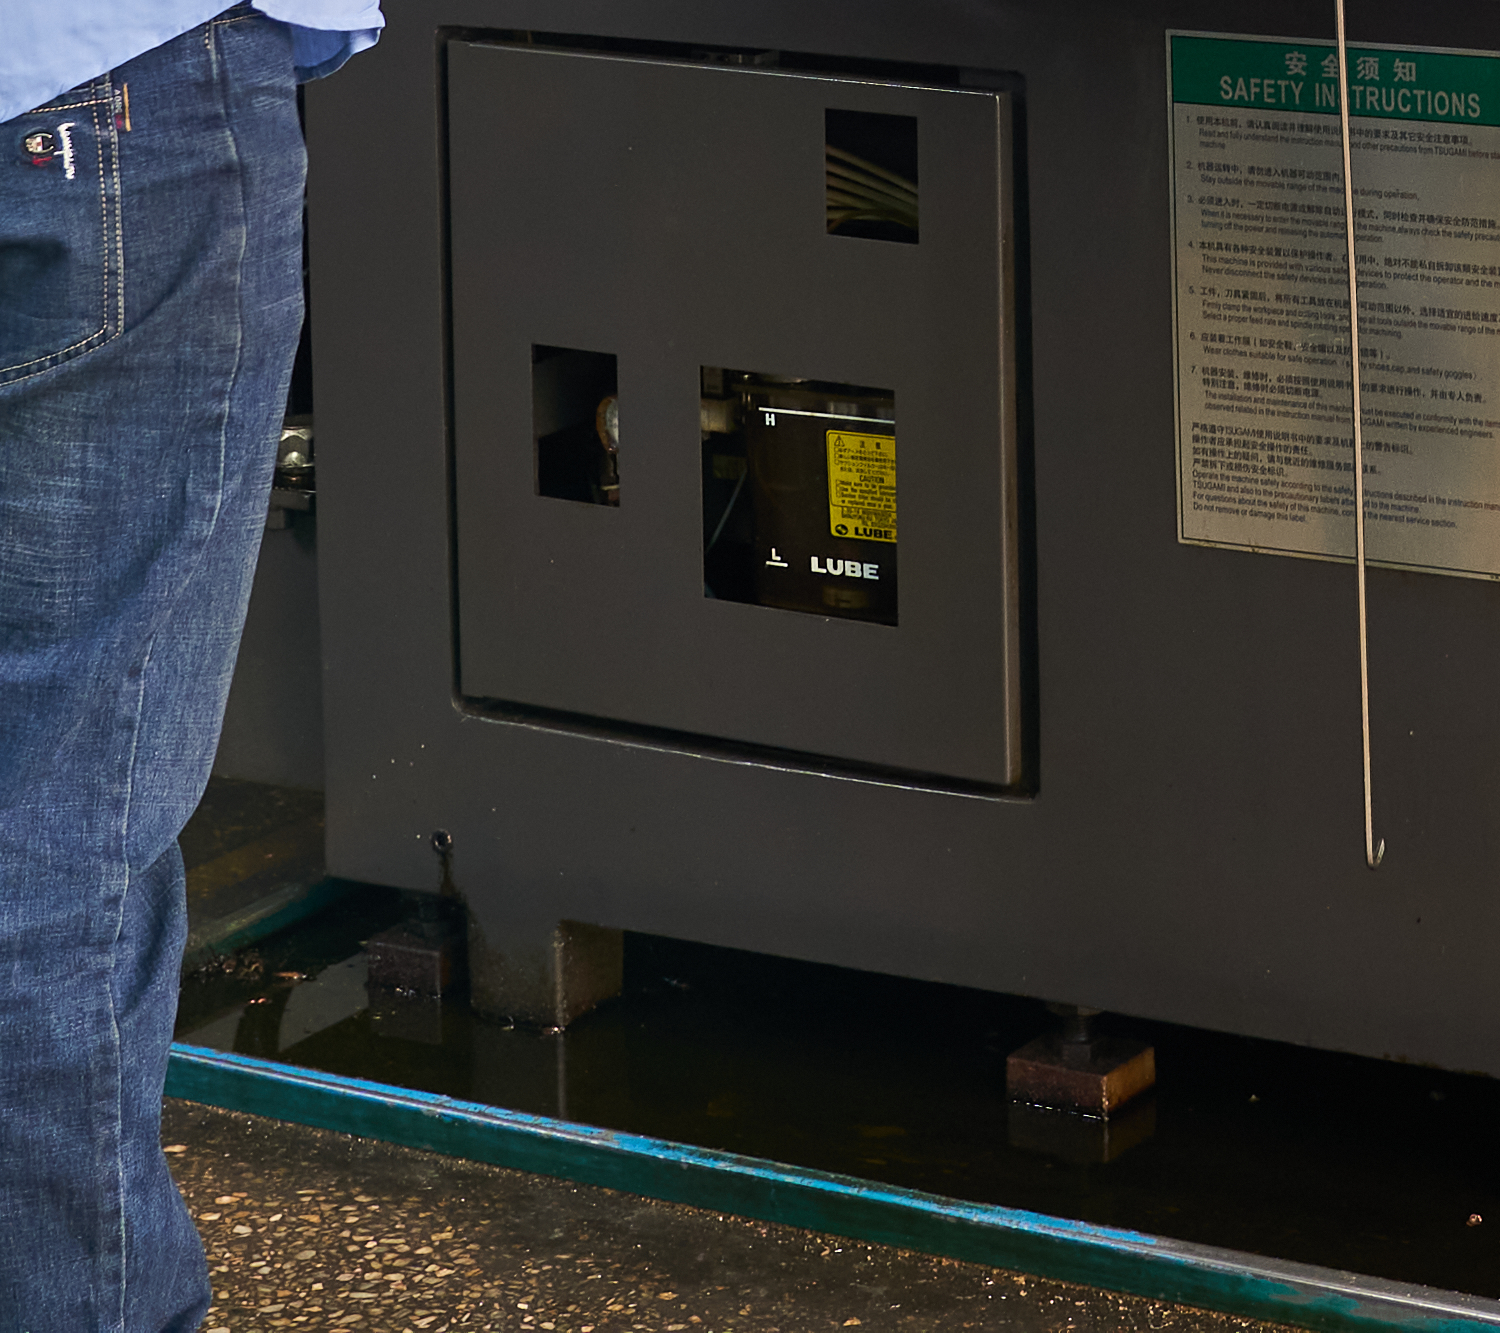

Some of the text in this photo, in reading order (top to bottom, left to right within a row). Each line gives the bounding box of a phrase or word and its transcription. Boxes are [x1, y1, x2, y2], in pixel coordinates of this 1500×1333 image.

[1285, 51, 1416, 82] 安全须知
[1220, 76, 1481, 118] SAFETY INTRUCTIONS
[1418, 145, 1466, 157] from TSUGAMI
[1201, 174, 1382, 197] Stay during
[1202, 254, 1492, 288] This provided to protect the operator and the
[1202, 265, 1298, 281] Never disconnect safety
[1204, 346, 1220, 356] Wear
[1222, 347, 1247, 358] clothes
[1276, 353, 1285, 362] for
[1287, 354, 1302, 364] safe
[1421, 367, 1442, 378] safety
[765, 413, 776, 427] H
[1192, 469, 1218, 480] Operate
[1219, 472, 1229, 482] the
[1231, 474, 1258, 485] machine
[1260, 477, 1279, 487] safely
[1281, 479, 1312, 491] according
[1314, 483, 1320, 492] to
[1394, 492, 1427, 504] described
[1436, 496, 1446, 506] the
[1448, 498, 1482, 510] instruction
[1193, 480, 1318, 503] TSUGAMI and also to the precautionary
[1193, 491, 1429, 526] For questions about the safety of this nearest service
[1193, 502, 1202, 511] Do
[1203, 503, 1214, 512] not
[1215, 504, 1239, 515] remove
[1240, 507, 1247, 516] or
[1248, 508, 1274, 519] damage
[1276, 511, 1287, 521] this
[854, 527, 892, 539] LUBE
[771, 548, 780, 561] L
[810, 555, 879, 581] LUBE
